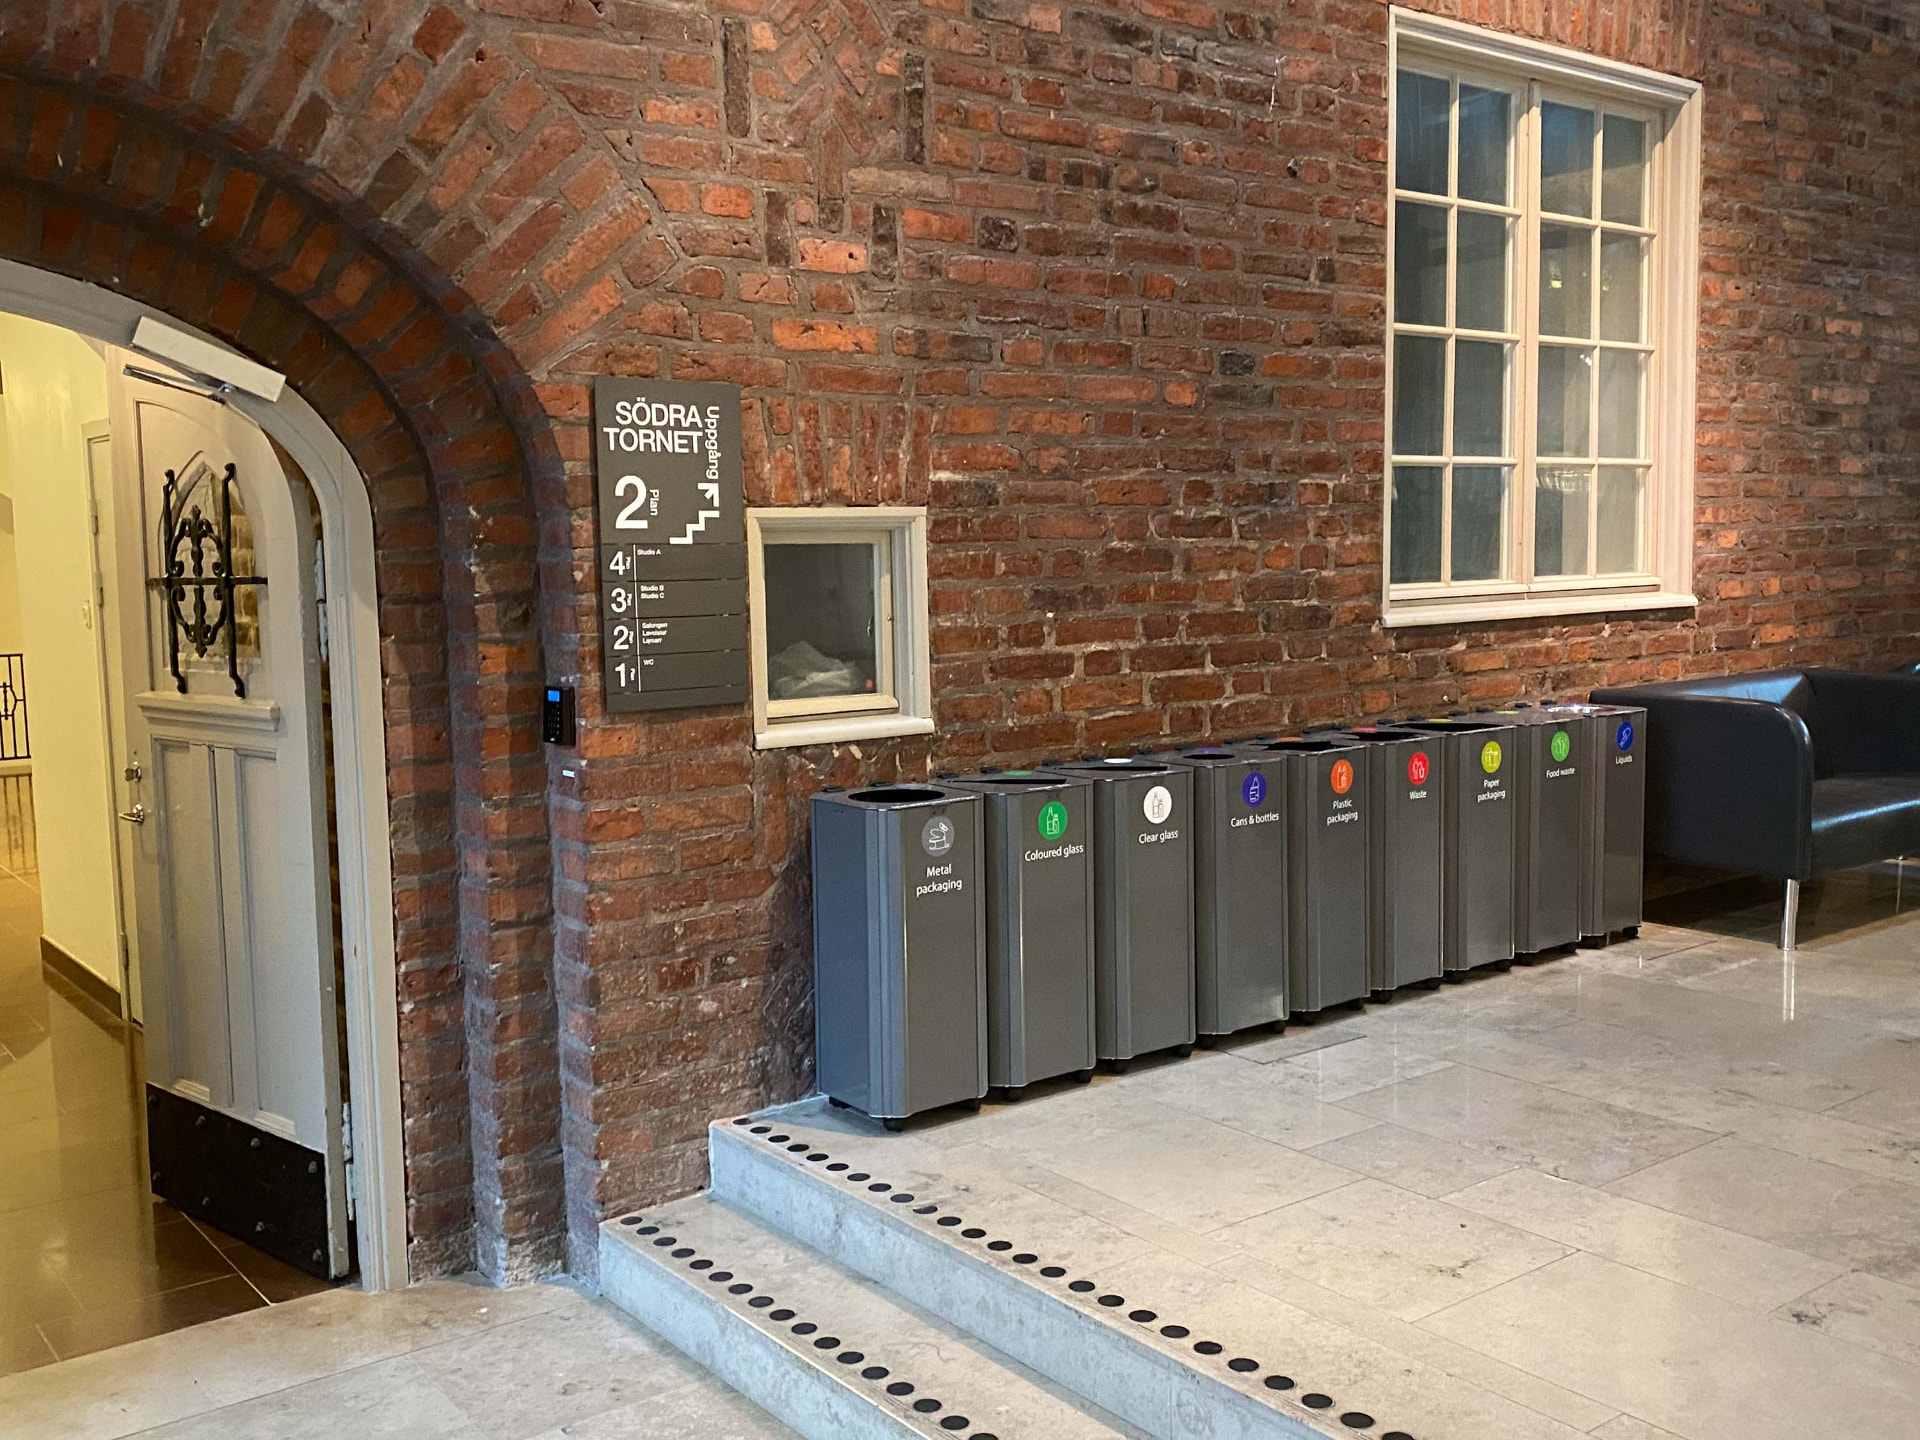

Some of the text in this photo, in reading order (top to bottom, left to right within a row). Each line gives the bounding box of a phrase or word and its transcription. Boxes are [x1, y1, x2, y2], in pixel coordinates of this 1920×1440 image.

[615, 396, 703, 428] SÖDRA
[602, 427, 704, 454] TORNET
[704, 405, 722, 480] Uppgång
[614, 475, 649, 530] 2
[650, 489, 660, 516] Plan
[609, 551, 626, 576] 4
[610, 588, 627, 613] 3
[613, 625, 630, 650] 2
[615, 662, 626, 688] 1
[1615, 753, 1633, 766] Liquids
[1546, 766, 1576, 779] Food waste
[1483, 778, 1500, 789] Paper
[1332, 798, 1353, 810] Plastic
[1409, 789, 1428, 800] Waste
[1477, 789, 1506, 803] packaging
[1230, 812, 1280, 828] Cans & bottles
[1326, 810, 1359, 826] packaging
[1138, 828, 1179, 845] Clear glass
[1024, 843, 1084, 862] Coloured glass
[926, 863, 952, 878] Metal
[916, 878, 963, 898] packaging
